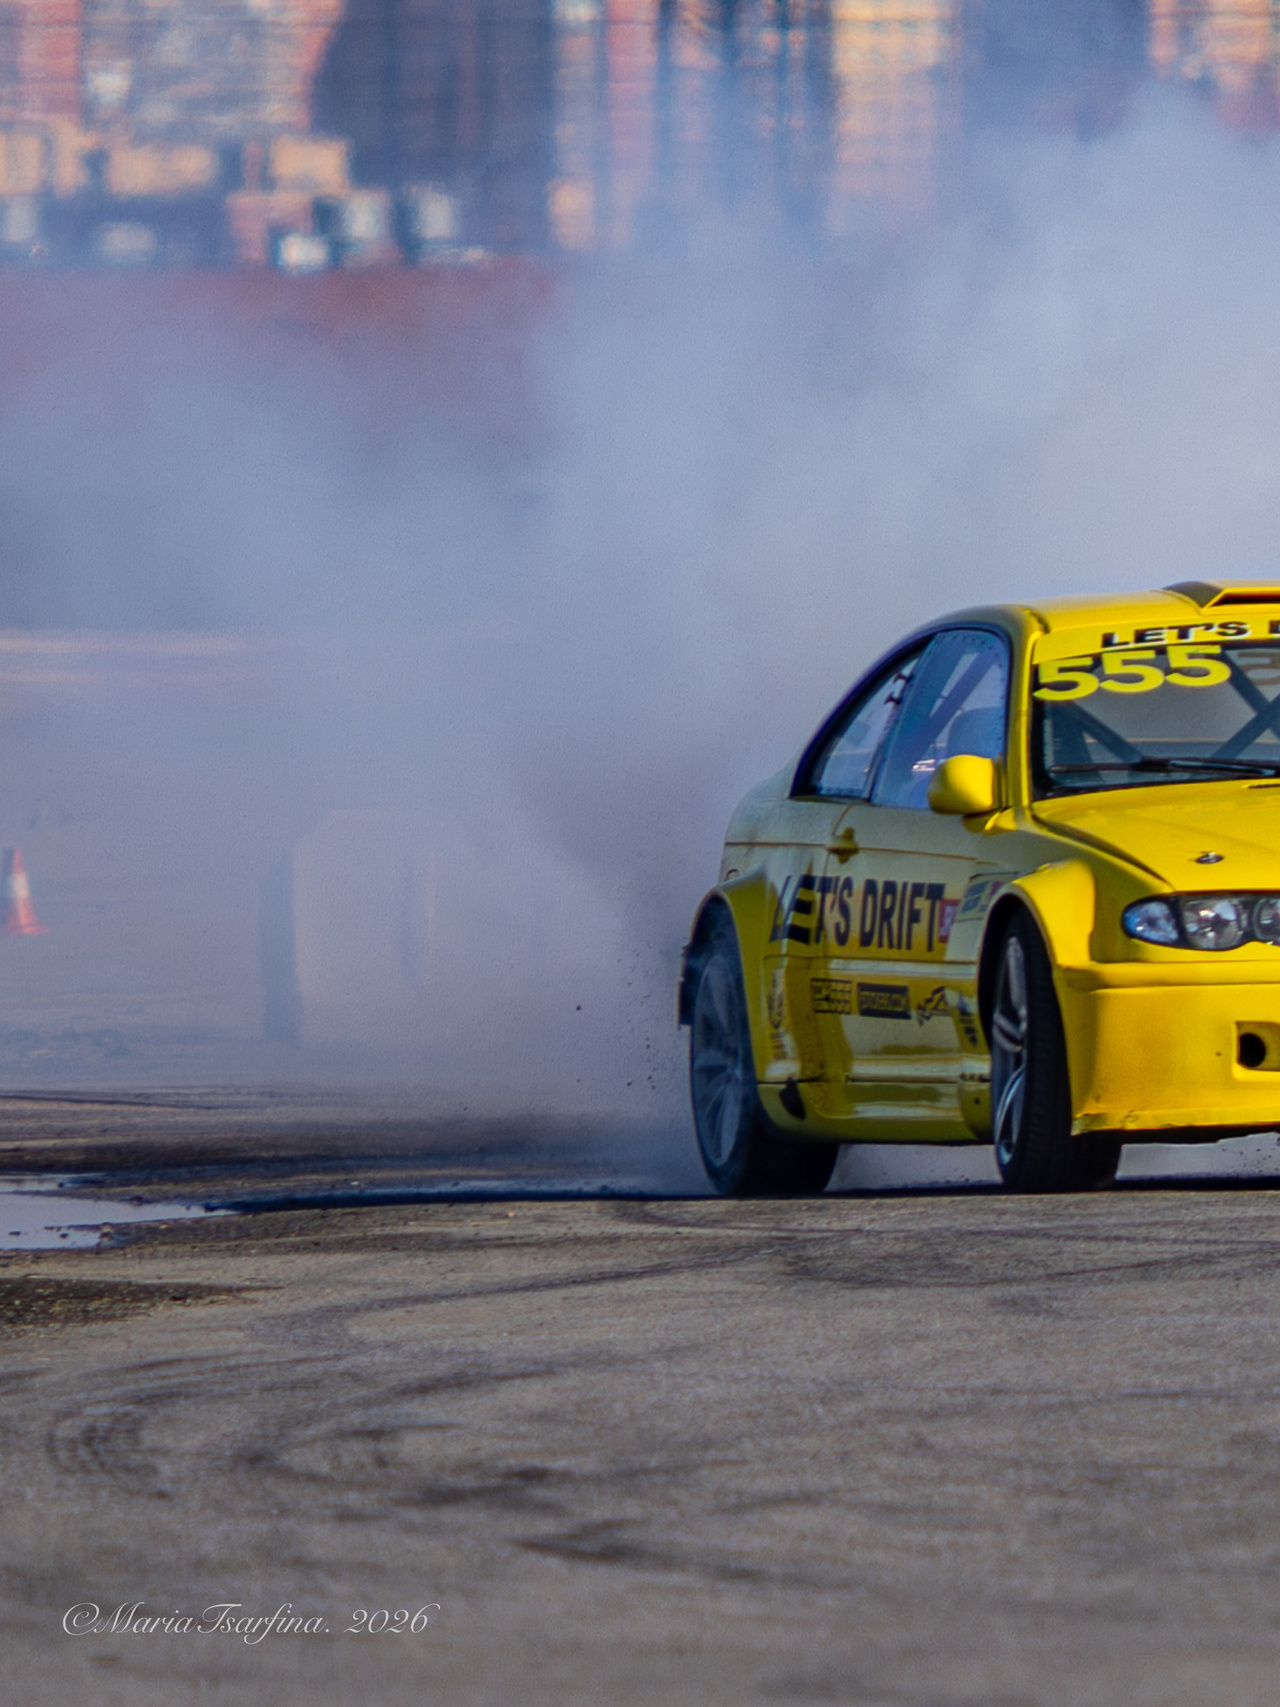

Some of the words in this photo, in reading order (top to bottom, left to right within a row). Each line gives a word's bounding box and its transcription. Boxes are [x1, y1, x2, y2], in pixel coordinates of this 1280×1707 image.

[1101, 621, 1251, 649] LET'S
[1033, 645, 1232, 700] 555
[769, 874, 854, 947] LET'S
[859, 878, 946, 952] DRIFT
